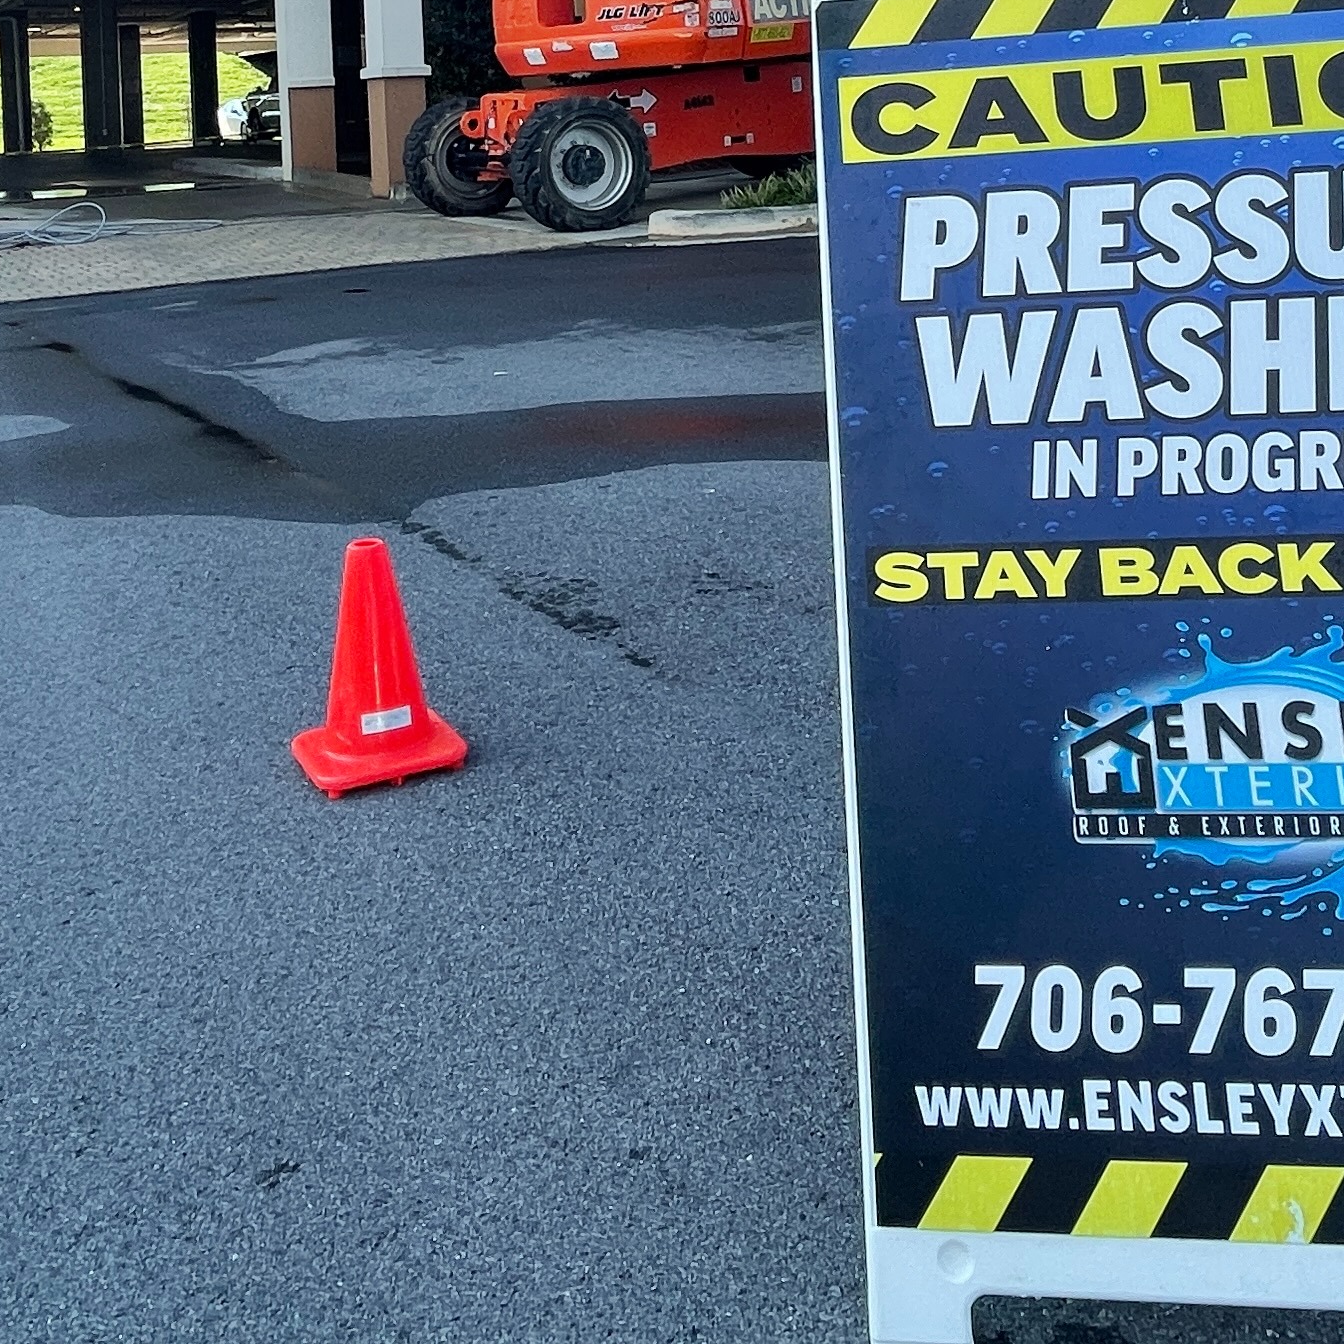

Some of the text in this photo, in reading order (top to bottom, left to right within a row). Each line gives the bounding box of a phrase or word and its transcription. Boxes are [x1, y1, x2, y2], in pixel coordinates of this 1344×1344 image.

[596, 3, 664, 20] JLG LIFT
[1031, 438, 1097, 500] IN
[874, 548, 1082, 603] STAY
[1100, 542, 1338, 597] BACK
[1077, 815, 1148, 836] ROOF
[1168, 816, 1181, 836] &
[1201, 814, 1343, 837] EXTERIOR
